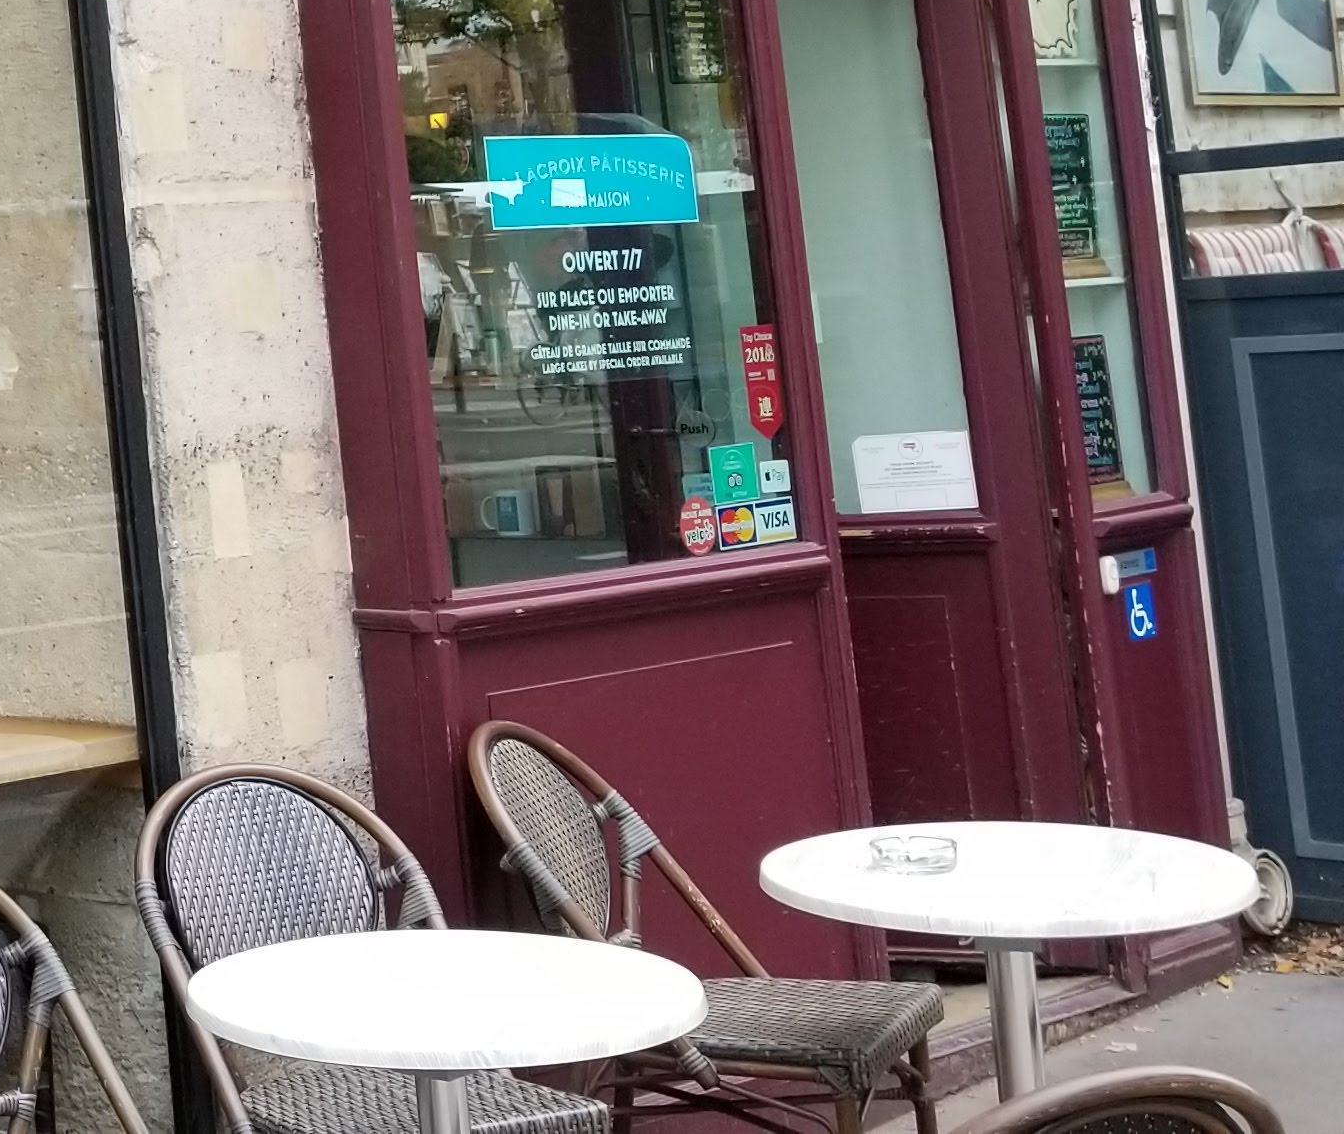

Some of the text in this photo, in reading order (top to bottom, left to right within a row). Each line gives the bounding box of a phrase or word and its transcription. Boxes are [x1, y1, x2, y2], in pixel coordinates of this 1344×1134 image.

[587, 190, 631, 208] MAISON
[562, 248, 643, 272] OUVERT 7/7
[536, 284, 675, 309] SUR PLACE OU EMPORTER
[548, 308, 668, 331] DINE-IN OR TAKE-AWAY
[530, 336, 692, 360] GÂTEAU DE GRANDE TAILLE SUR COMMANDE
[542, 352, 684, 375] LARGE CAKES BY SPECIAL ORDER AVAILABLE
[680, 423, 709, 435] Push
[760, 510, 790, 529] VISA
[686, 528, 705, 545] yelp
